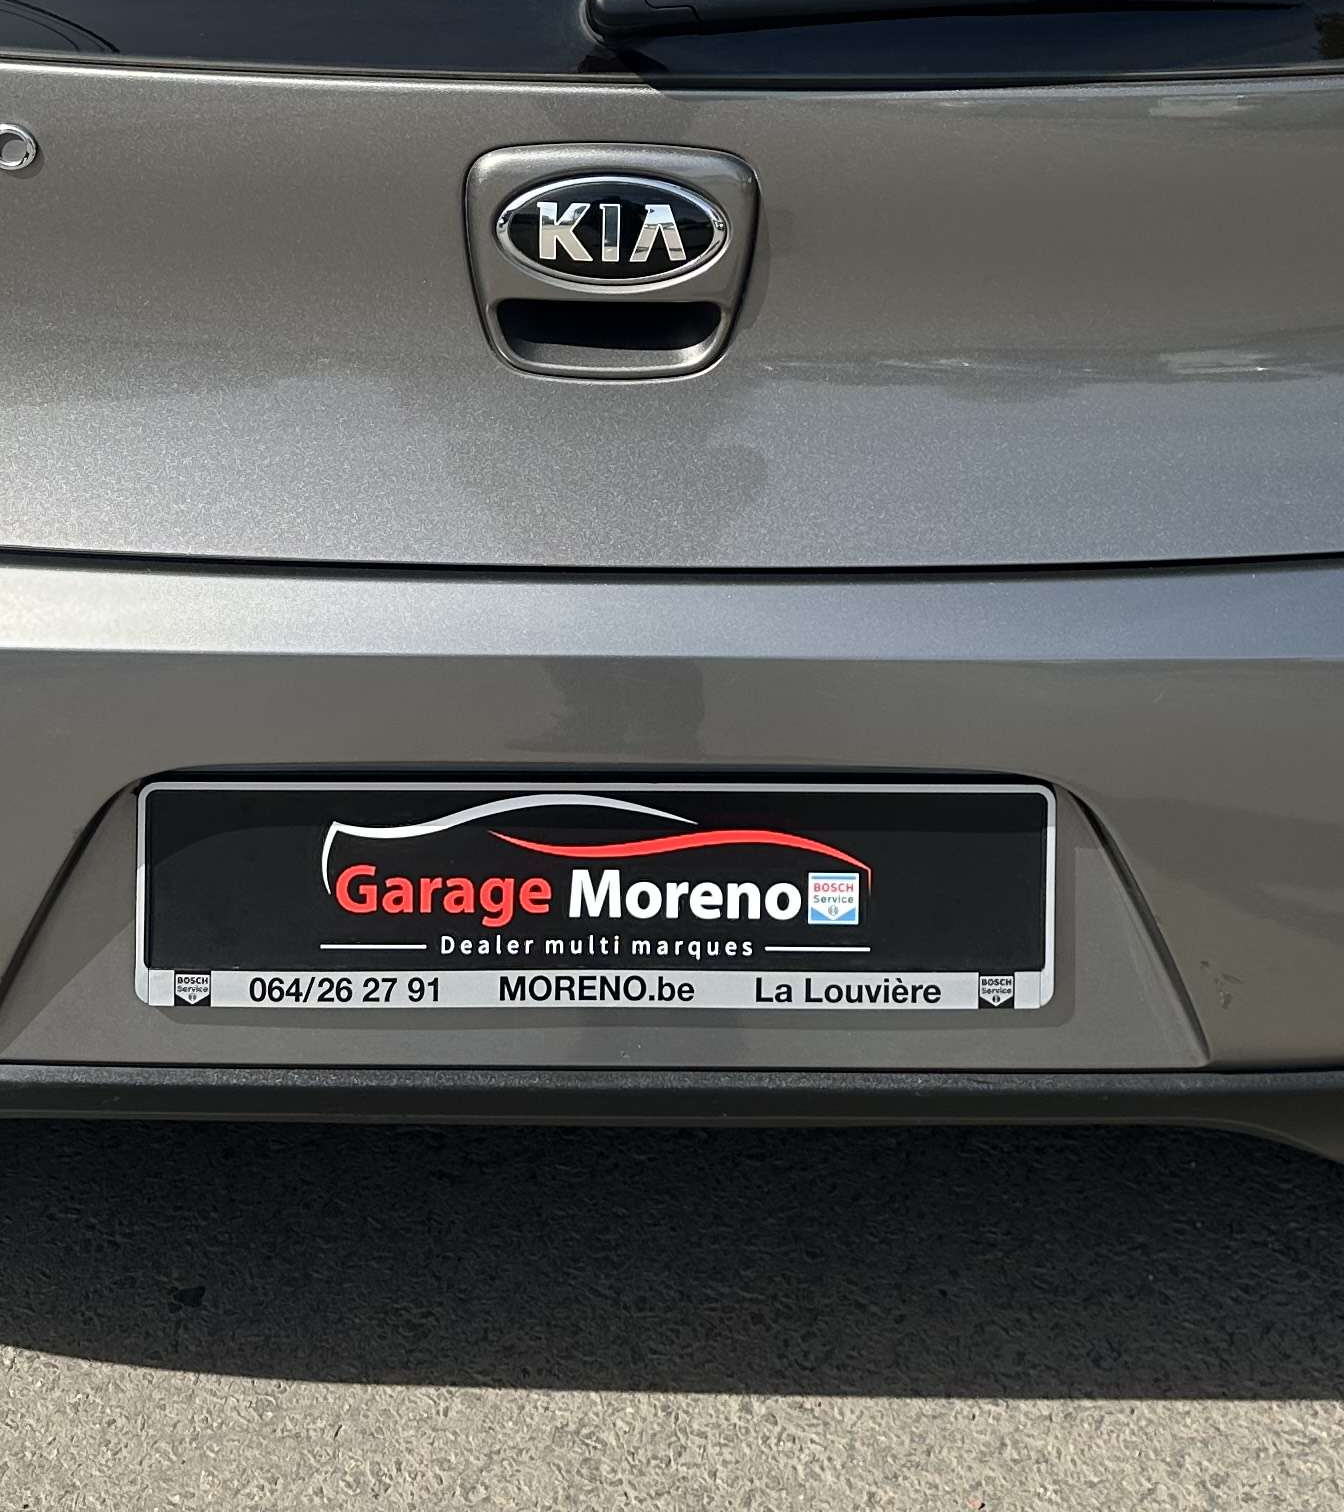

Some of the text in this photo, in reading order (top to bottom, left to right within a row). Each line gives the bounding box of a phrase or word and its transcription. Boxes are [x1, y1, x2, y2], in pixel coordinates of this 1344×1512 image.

[536, 201, 687, 262] KIA
[335, 864, 802, 927] Garage Moreno
[813, 882, 855, 893] BOSCH
[813, 894, 855, 904] Service
[440, 934, 754, 961] Dealer multi marques
[177, 976, 208, 984] BOSCH
[177, 985, 208, 993] Service
[249, 976, 440, 1003] 064/26 27 91
[499, 974, 695, 1002] MORENO.be
[981, 978, 1012, 986] BOSCH
[755, 977, 942, 1004] La Louvière
[981, 987, 1012, 995] Service
